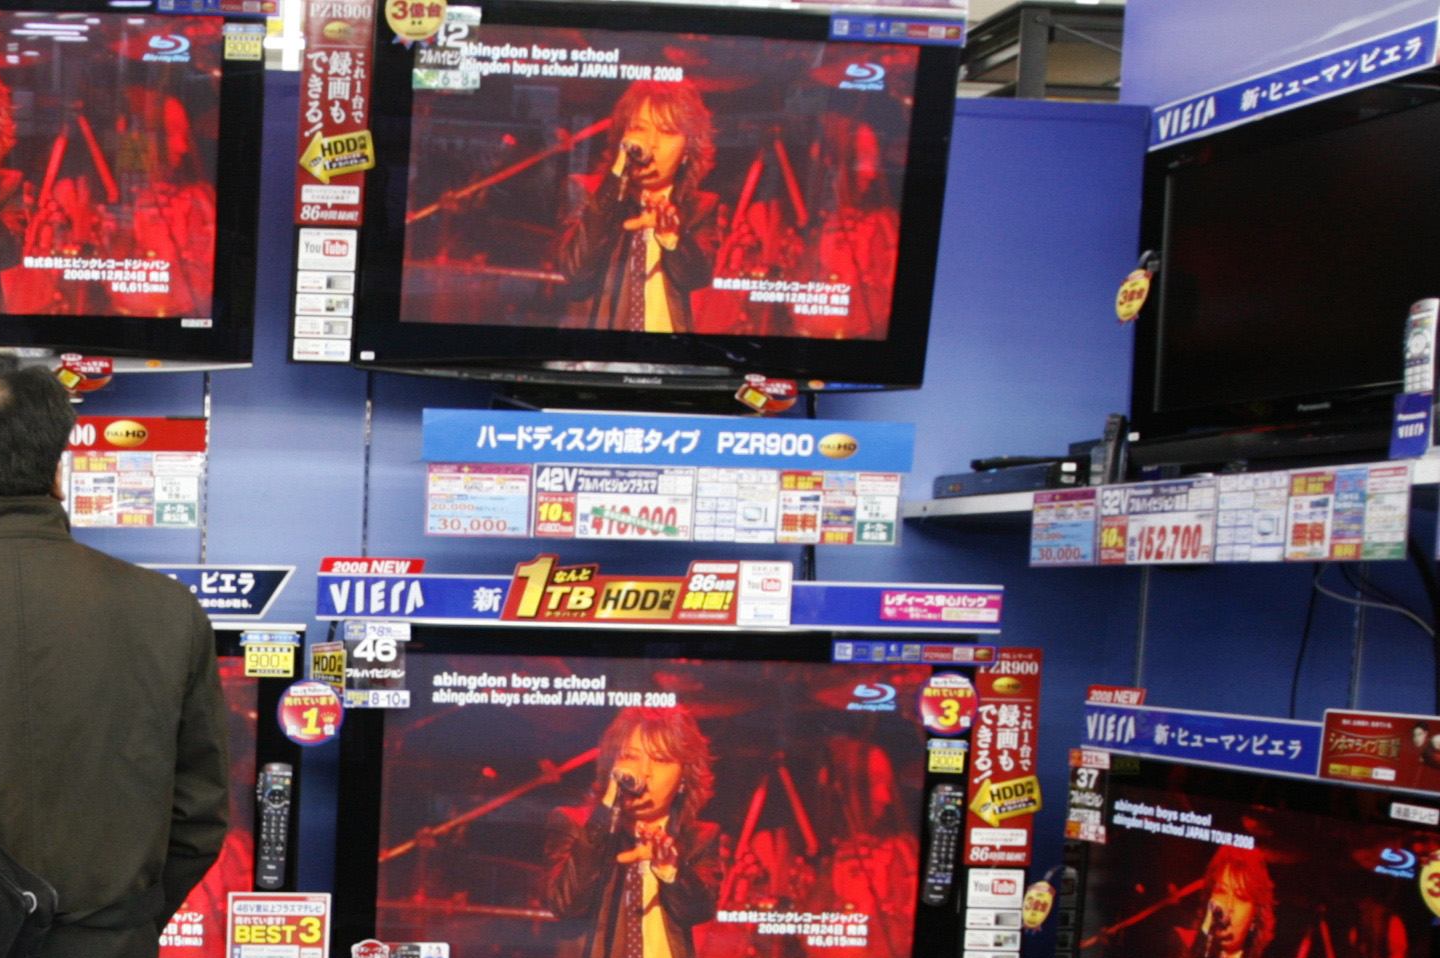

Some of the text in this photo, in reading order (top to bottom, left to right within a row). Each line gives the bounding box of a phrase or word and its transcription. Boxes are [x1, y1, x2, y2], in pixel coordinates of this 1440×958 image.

[460, 43, 619, 62] abingdon boys school
[512, 61, 540, 77] boys
[542, 61, 578, 77] school
[580, 63, 617, 79] JAPAN
[620, 65, 652, 79] TOUR
[654, 66, 683, 81] 2008
[1239, 36, 1422, 112] 新・ヒューマンビエラ
[327, 50, 352, 124] 録画も
[1158, 96, 1216, 140] VIERA
[476, 425, 815, 457] ハードディスク内蔵タイプ PZR900
[536, 467, 576, 492] 42V
[437, 517, 508, 532] 30,000
[1136, 524, 1203, 561] 152,700
[331, 559, 410, 574] 2008 NEW
[553, 568, 593, 584] なんと
[329, 579, 424, 615] VIERA
[472, 587, 503, 612] 新
[352, 638, 397, 663] 46
[432, 673, 606, 693] abingdon boys school
[432, 689, 677, 708] abingdon boys school JAPAN TOUR 2008
[1089, 688, 1140, 704] 2008 NEW
[996, 704, 1022, 773] 録画も
[1085, 711, 1136, 744] VIERA
[1153, 722, 1303, 760] 新・ヒューマンビエラ
[1075, 767, 1099, 789] 37
[1114, 798, 1213, 827] abingdon boys school
[1144, 818, 1161, 834] boys
[1161, 821, 1185, 837] school
[1185, 825, 1211, 842] JAPAN
[1211, 829, 1233, 845] TOUR
[1232, 834, 1256, 851] 2008
[717, 910, 869, 924] 株式会社エピックレコードジャパン
[758, 923, 844, 936] 2008年12月24日
[234, 916, 322, 944] BEST 3
